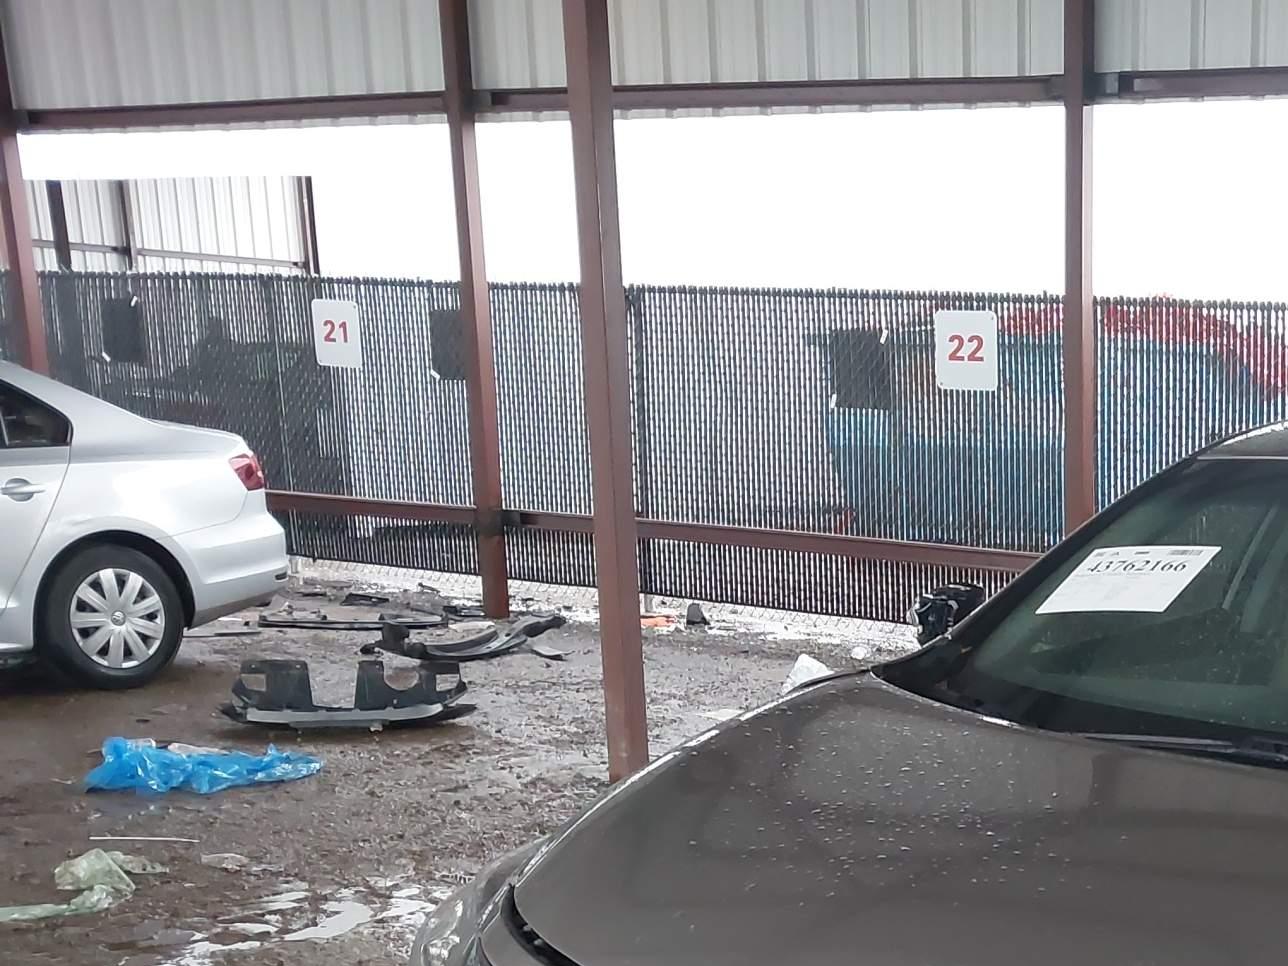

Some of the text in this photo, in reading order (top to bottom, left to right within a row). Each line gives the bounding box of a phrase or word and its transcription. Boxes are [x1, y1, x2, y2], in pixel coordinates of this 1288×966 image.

[323, 319, 348, 343] 21
[947, 334, 984, 363] 22
[1087, 560, 1188, 573] 43762166
